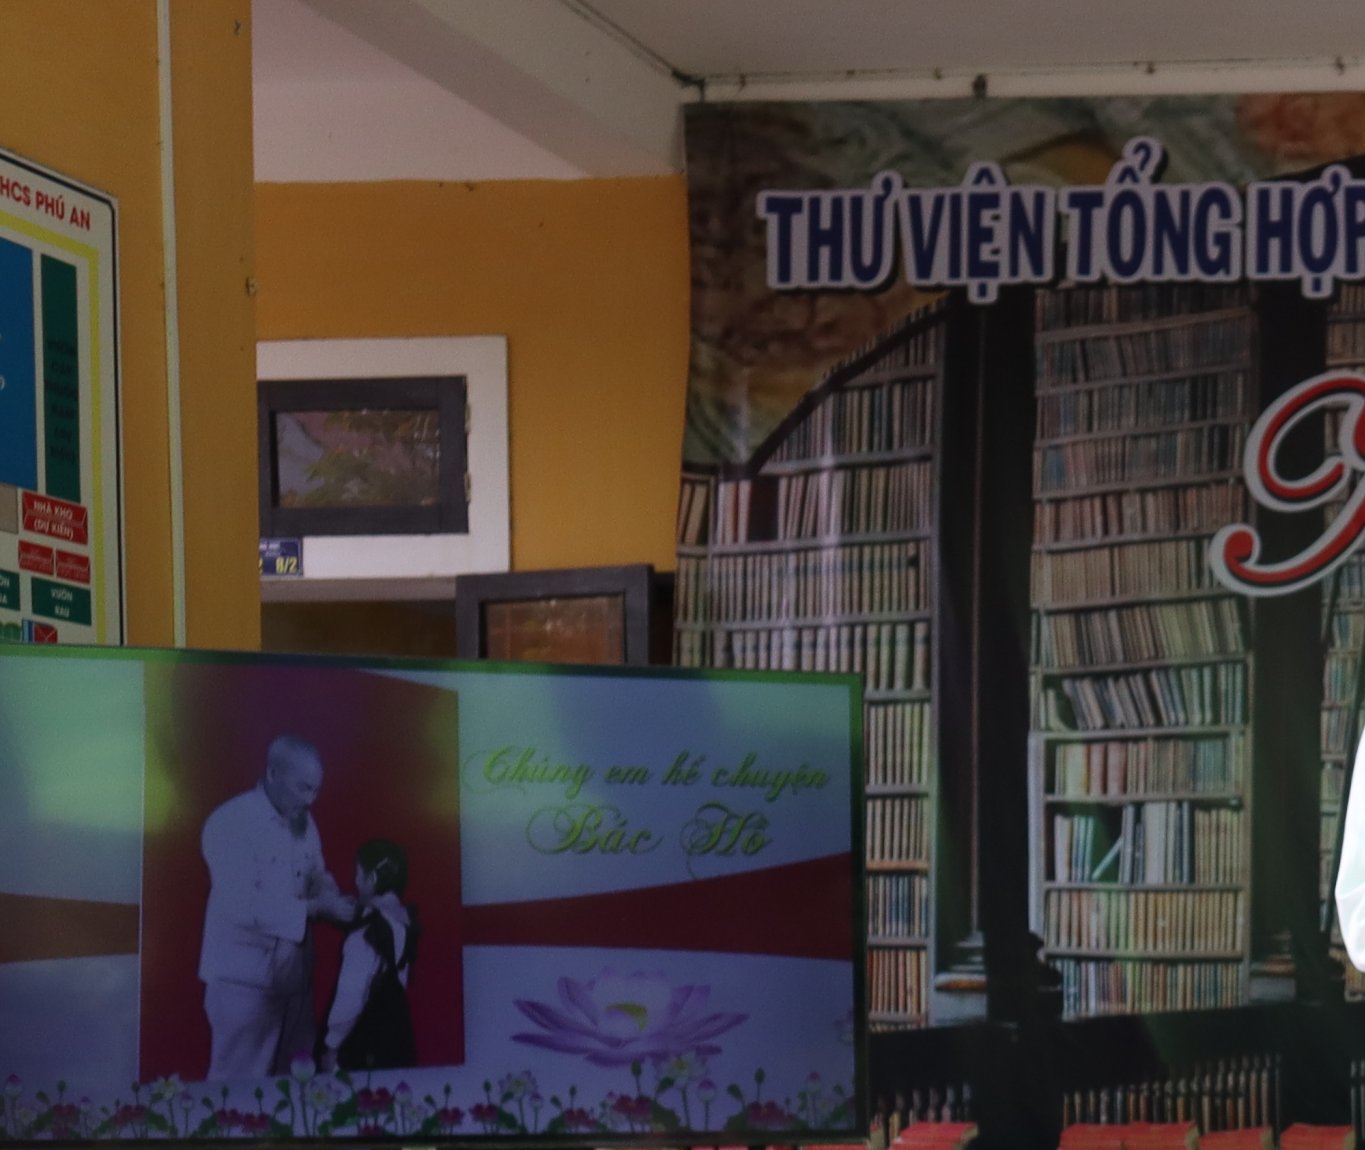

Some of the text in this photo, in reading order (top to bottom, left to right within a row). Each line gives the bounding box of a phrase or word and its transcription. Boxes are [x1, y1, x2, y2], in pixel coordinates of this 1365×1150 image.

[36, 190, 65, 220] PHÚ
[70, 205, 91, 232] AN
[761, 170, 900, 288] THƯ
[903, 162, 1054, 303] VIỆN
[1062, 137, 1243, 284] TỔNG
